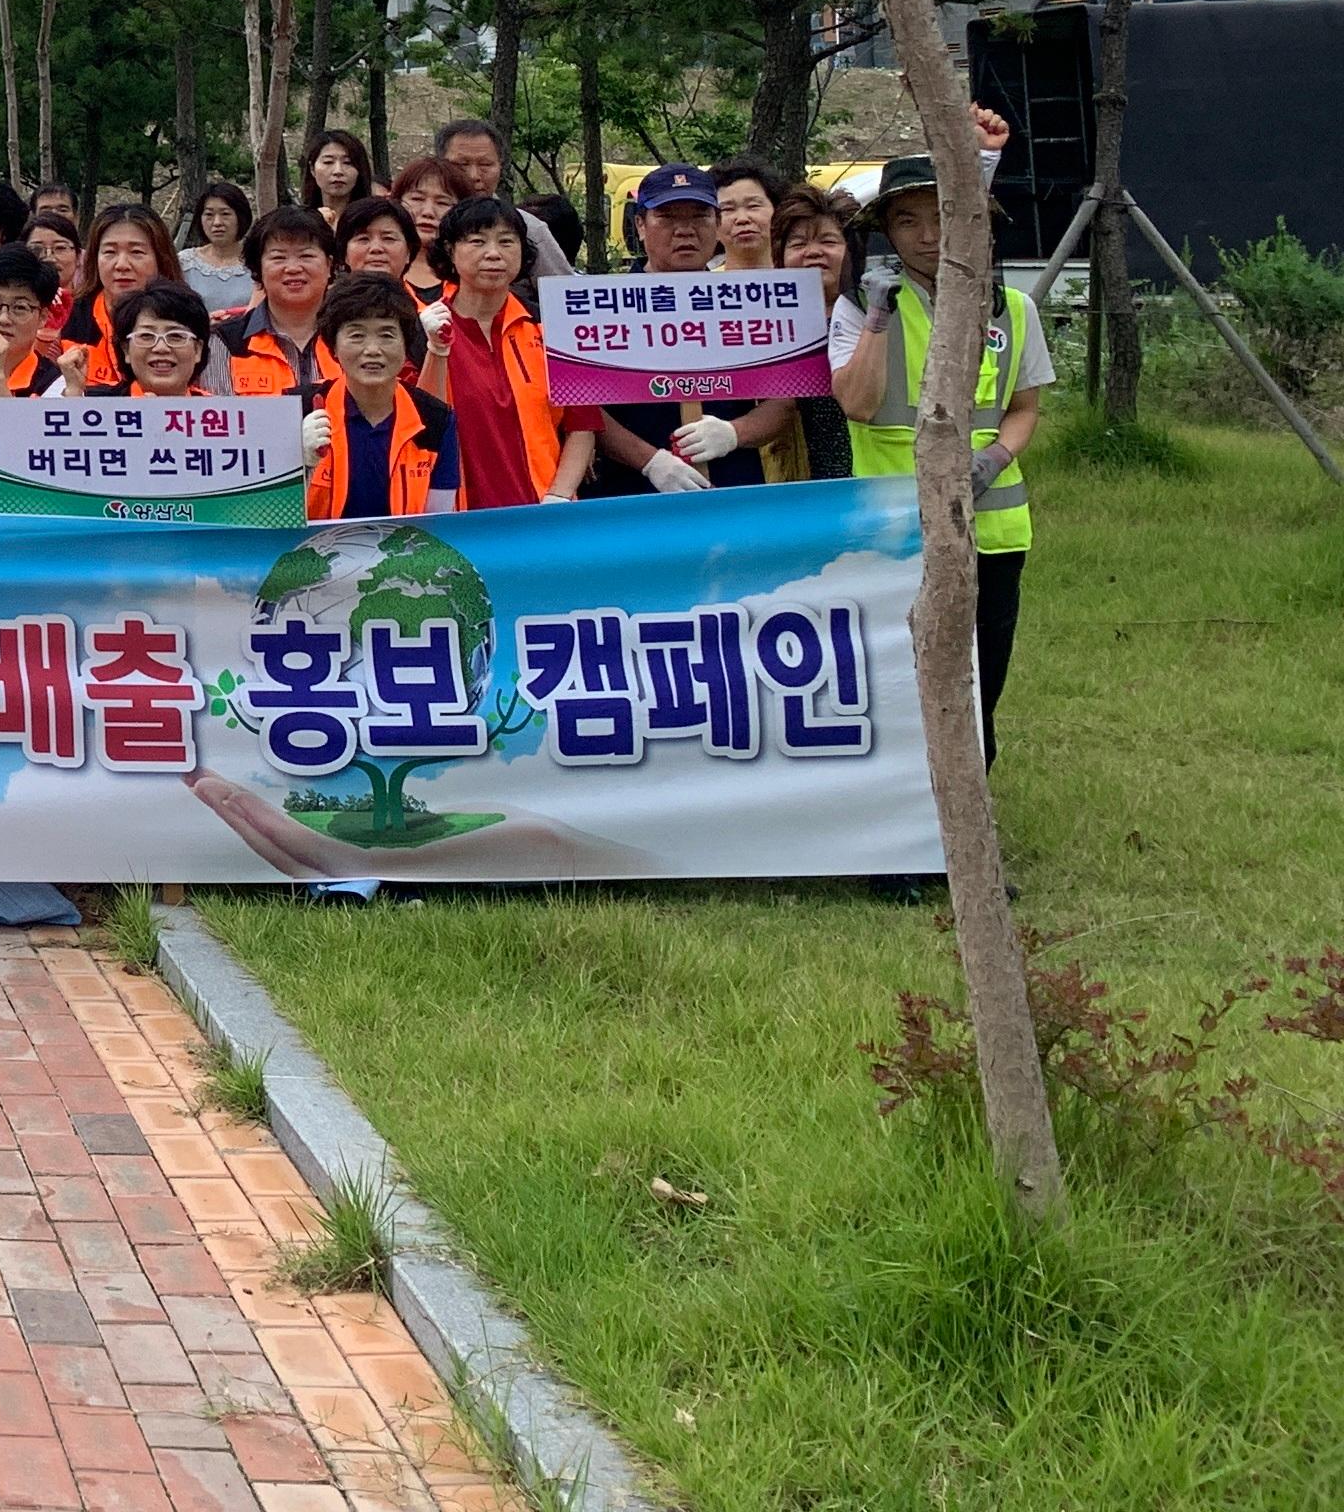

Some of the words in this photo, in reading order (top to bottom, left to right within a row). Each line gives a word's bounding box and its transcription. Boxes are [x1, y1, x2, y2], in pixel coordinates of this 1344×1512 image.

[565, 285, 677, 316] 분리배출
[688, 282, 800, 311] 실천하면
[574, 323, 630, 352] 연간
[642, 321, 707, 348] 10억
[719, 319, 795, 346] 절감!!
[676, 377, 733, 395] 양산시
[44, 410, 143, 437] 모으면
[164, 409, 246, 437] 자원!
[28, 449, 127, 476] 버리면
[149, 448, 266, 476] 쓰레기!
[132, 503, 194, 522] 양산시
[247, 618, 483, 768] 홍보
[523, 606, 865, 757] 캠페인
